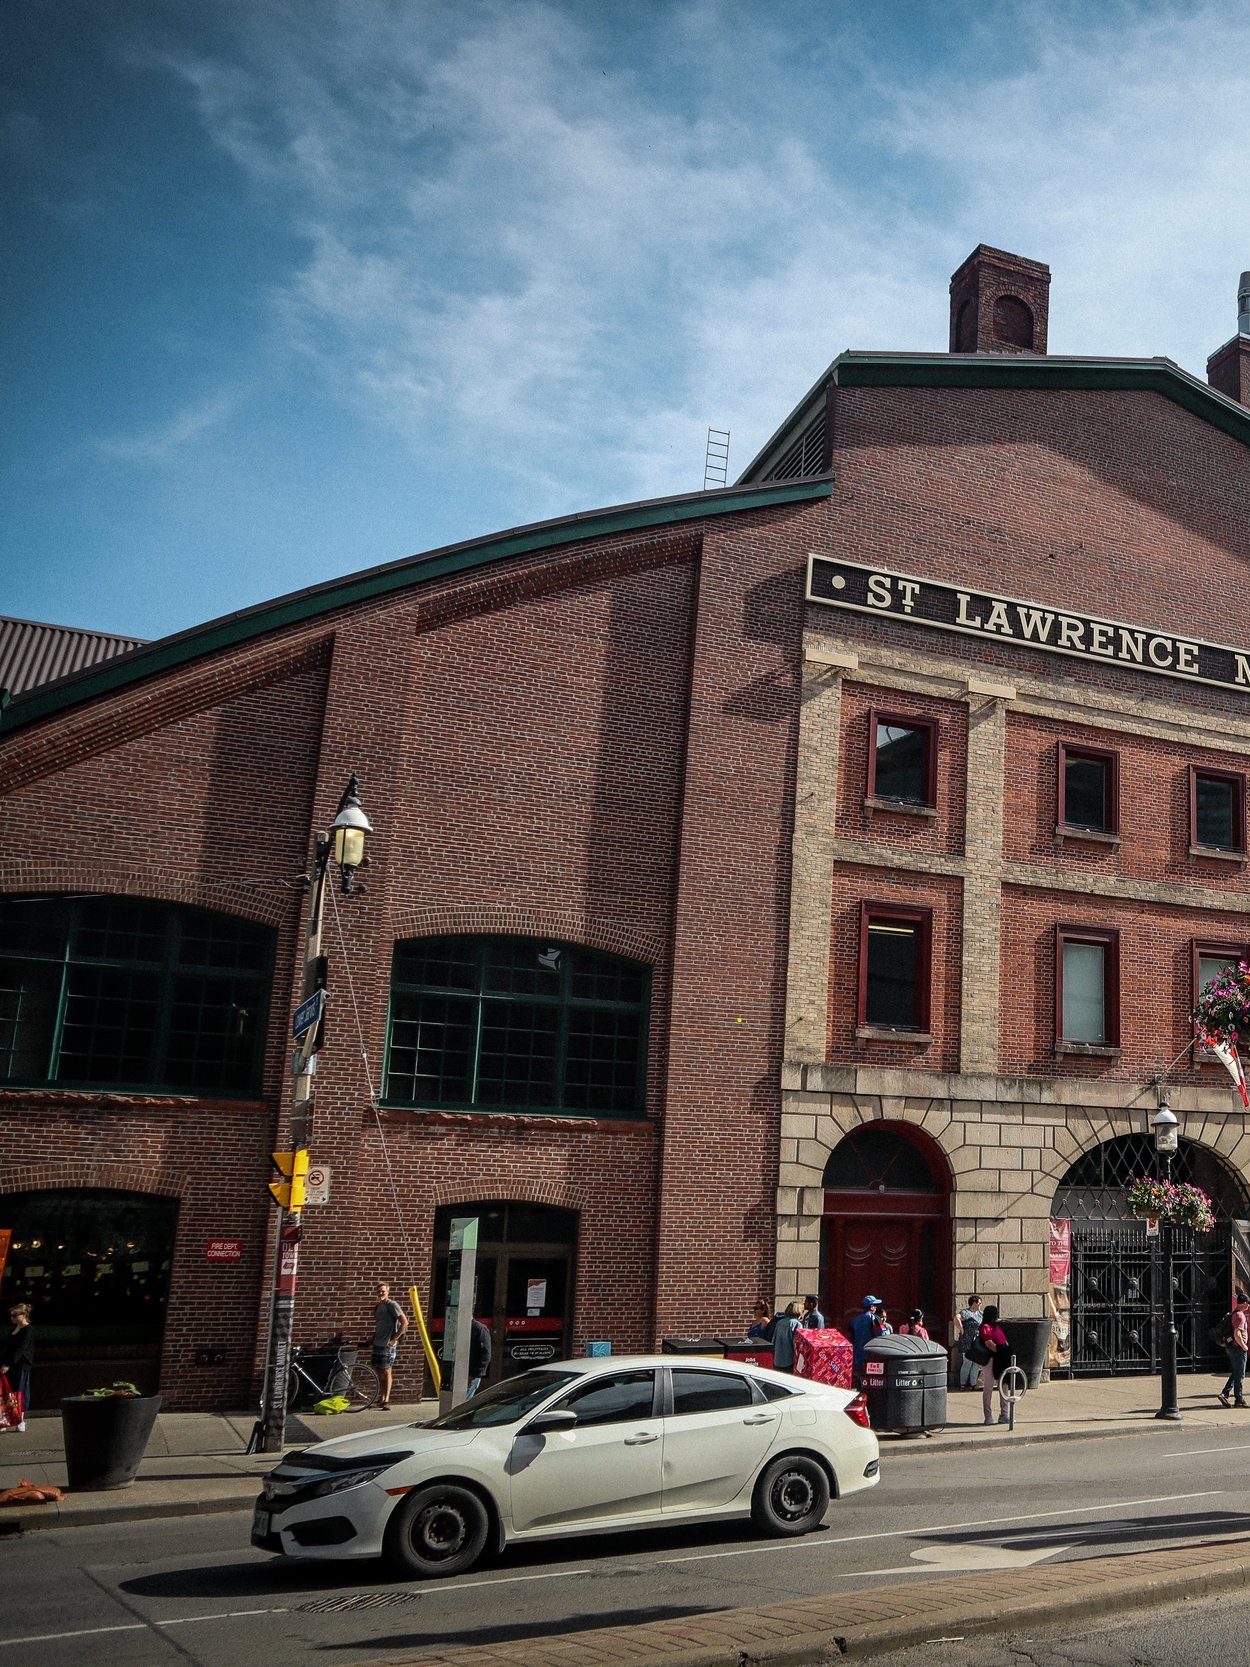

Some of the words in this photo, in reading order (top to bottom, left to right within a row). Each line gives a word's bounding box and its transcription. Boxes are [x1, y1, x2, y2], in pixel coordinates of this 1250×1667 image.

[956, 593, 1199, 674] LAWRENCE
[276, 1341, 287, 1366] MARKET
[274, 1368, 284, 1400] LAWRENCE
[870, 1378, 884, 1386] Litter
[896, 1378, 910, 1386] Litter
